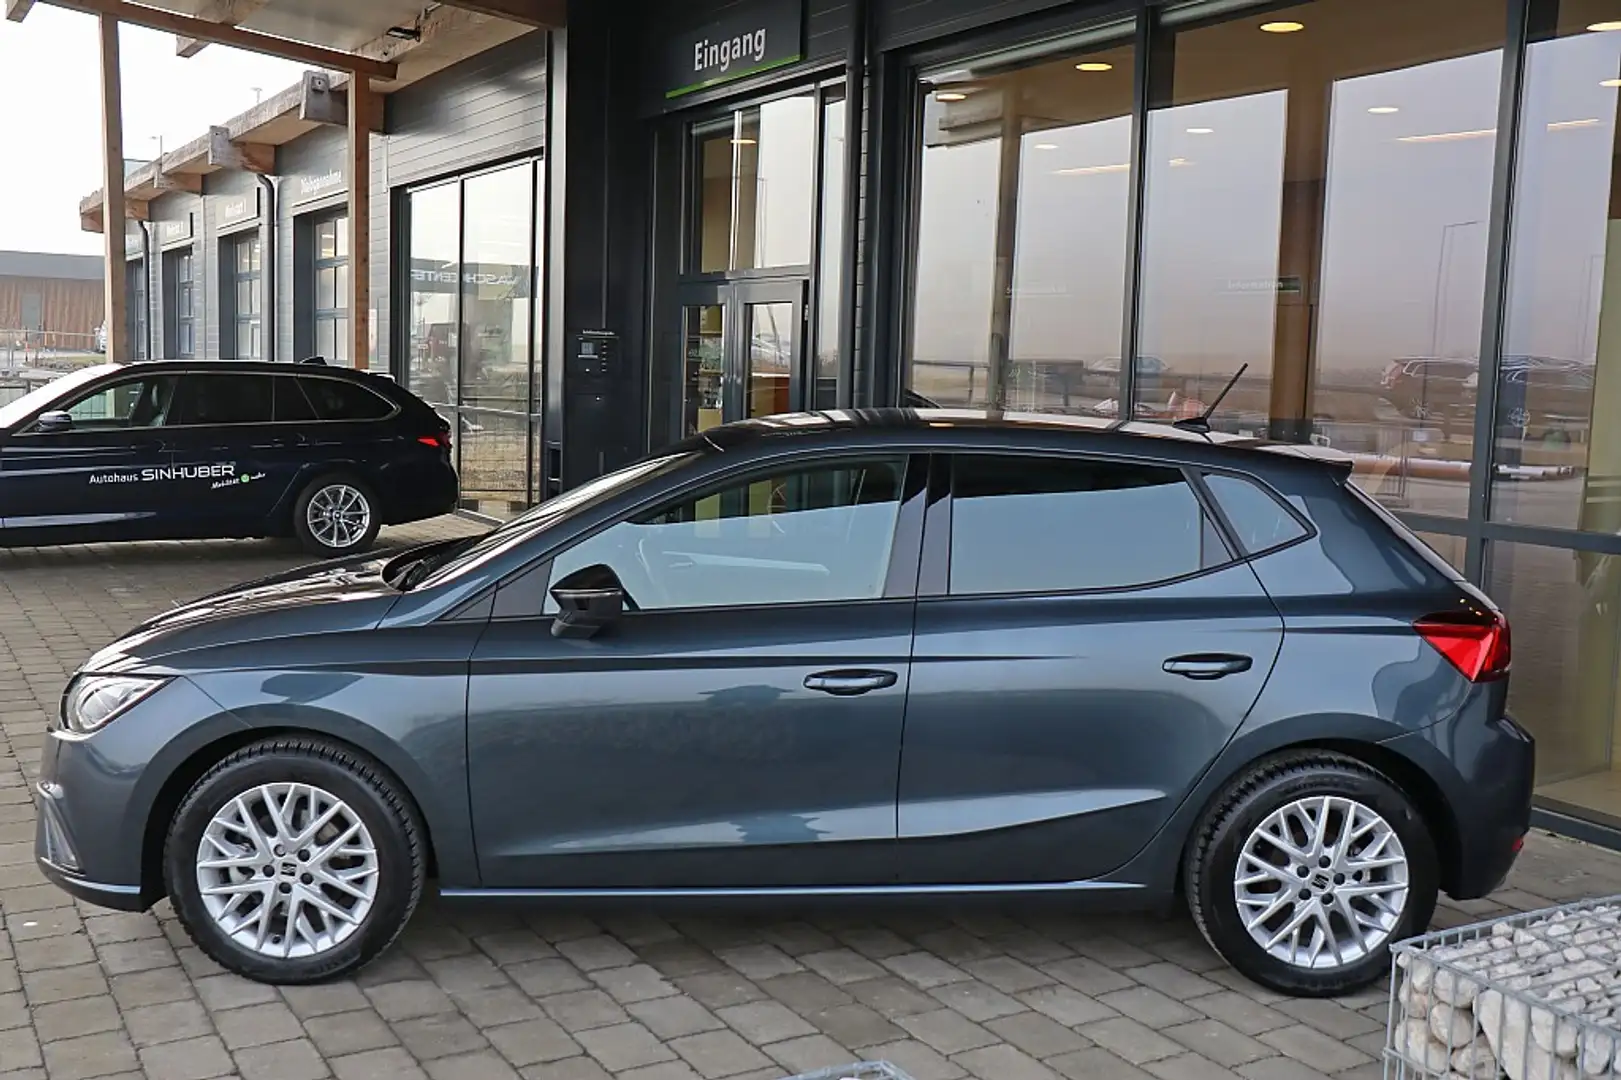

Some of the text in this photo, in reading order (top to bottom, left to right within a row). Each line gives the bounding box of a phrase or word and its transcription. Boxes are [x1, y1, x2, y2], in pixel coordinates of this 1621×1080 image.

[694, 28, 766, 72] Eingang
[89, 465, 235, 484] Autohaus SINHUBER
